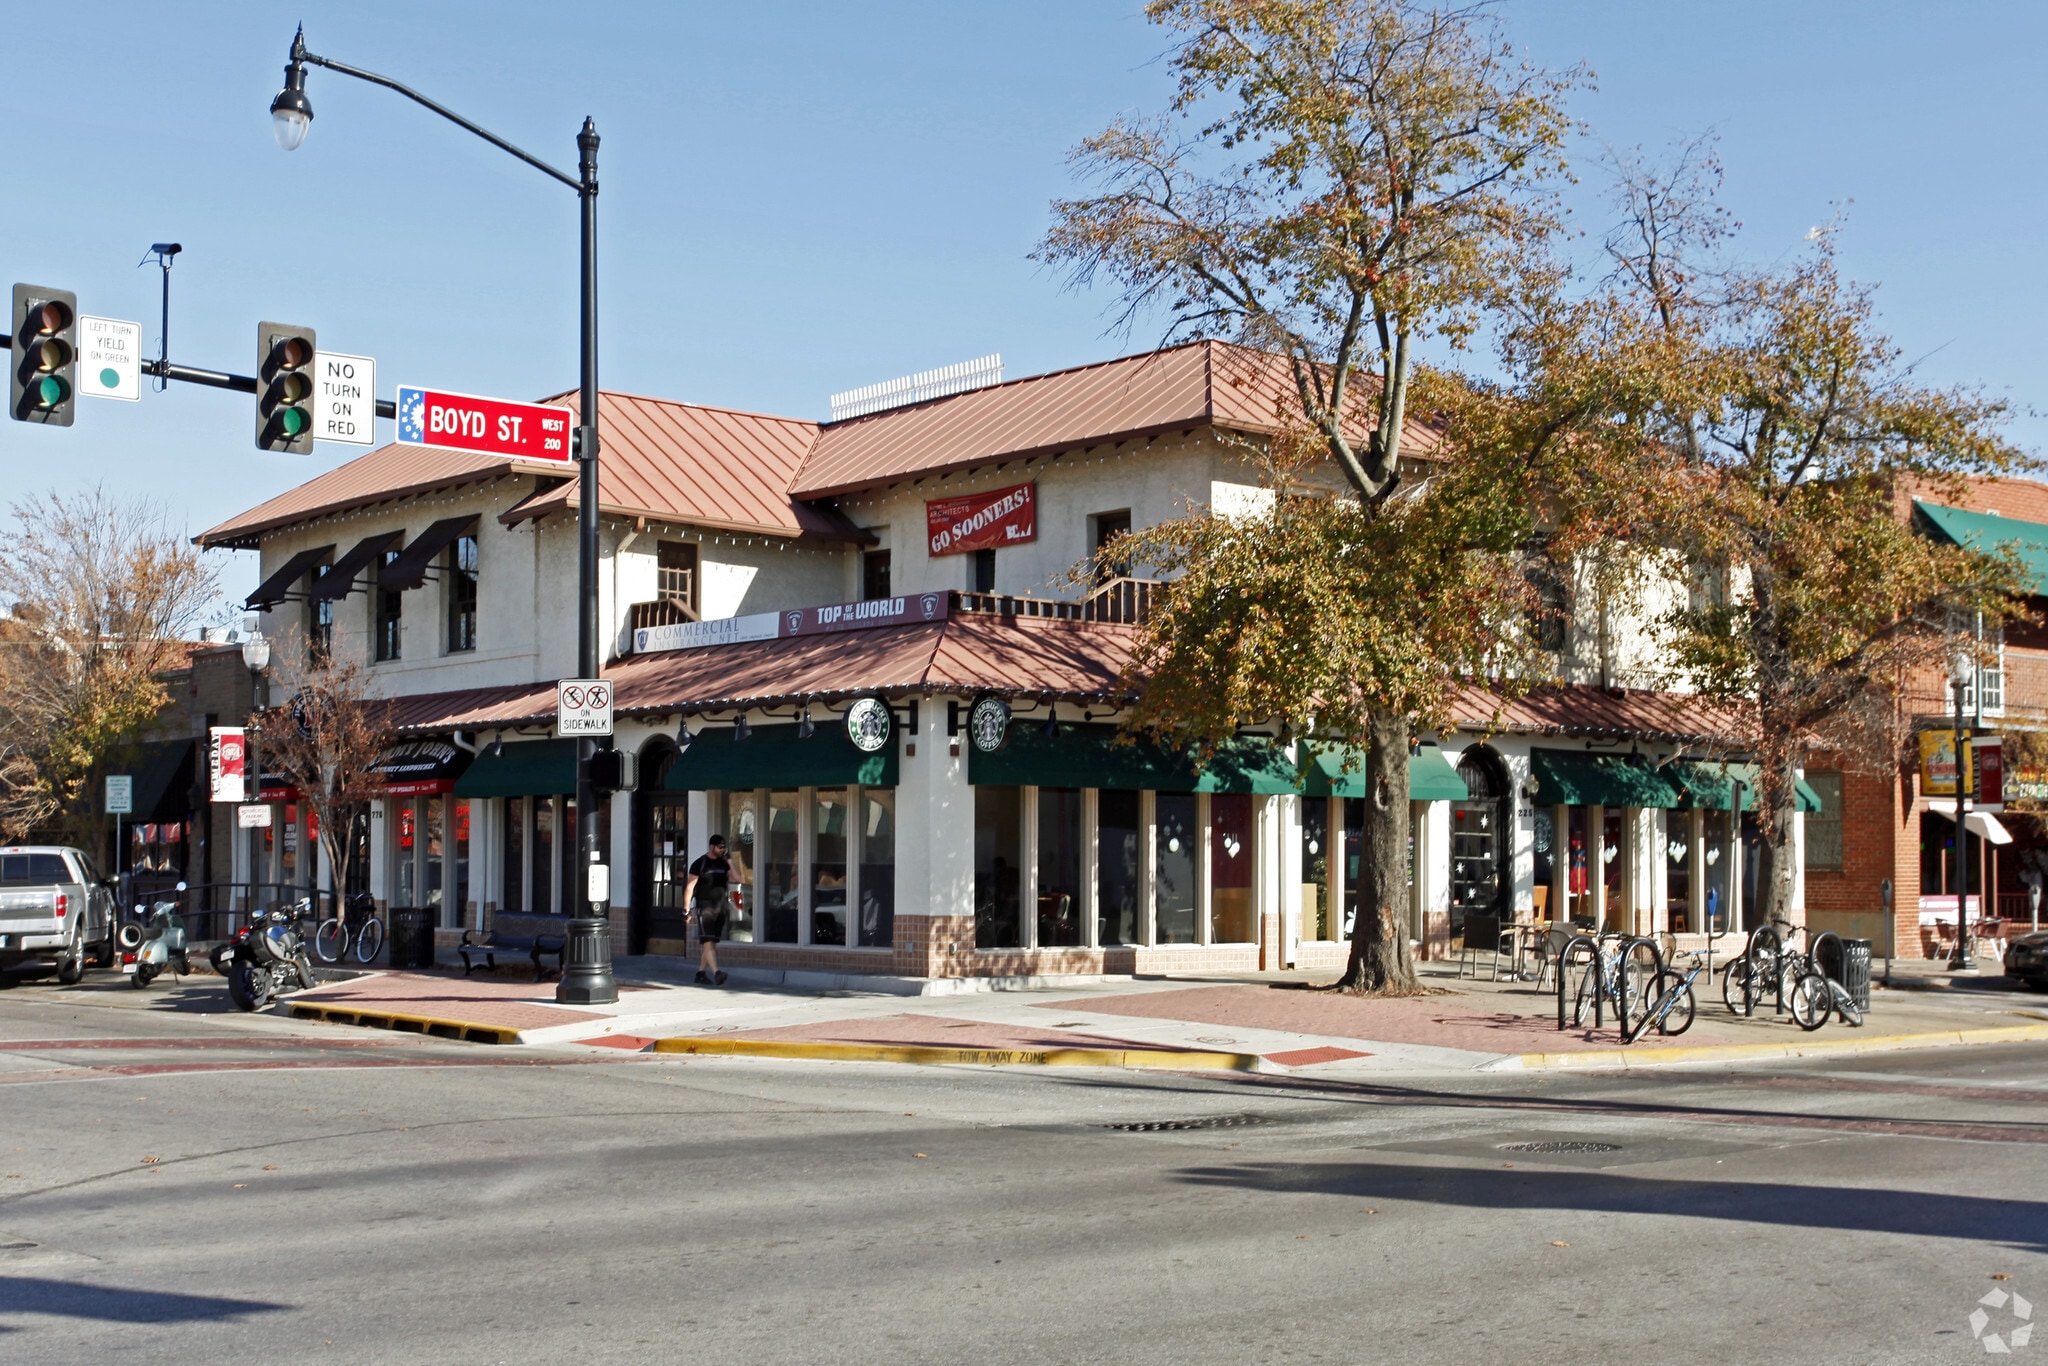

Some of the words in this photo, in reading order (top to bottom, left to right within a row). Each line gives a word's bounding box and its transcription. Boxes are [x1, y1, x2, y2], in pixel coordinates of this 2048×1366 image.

[89, 321, 107, 332] LEFT
[112, 325, 132, 336] TURN
[97, 336, 125, 351] YIELD
[90, 350, 101, 360] ON
[105, 353, 130, 363] GREEN
[328, 361, 355, 379] NO
[323, 382, 360, 399] TURN
[332, 402, 351, 416] ON
[328, 420, 356, 436] RED
[430, 405, 486, 438] BOYD
[497, 415, 527, 444] ST.
[541, 418, 564, 432] WEST
[544, 437, 561, 450] 200
[930, 505, 970, 518] ARCHITECTS
[931, 530, 950, 553] GO
[951, 486, 1031, 541] SOONERS!
[817, 605, 843, 625] TOP
[844, 604, 854, 613] OF
[855, 597, 905, 620] WORLD
[842, 611, 855, 622] THE
[654, 618, 740, 640] COMMERCIAL
[580, 709, 591, 717] ON
[850, 700, 888, 724] STARBUCKS
[972, 701, 1004, 724] STARBUCKS
[563, 719, 608, 730] SIDEWALK
[854, 733, 884, 749] COFFEE
[975, 736, 1001, 749] COFFEE
[412, 741, 457, 765] JOHN'S
[959, 1050, 1013, 1063] TOW-AWAY
[1019, 1051, 1048, 1064] ZONE
